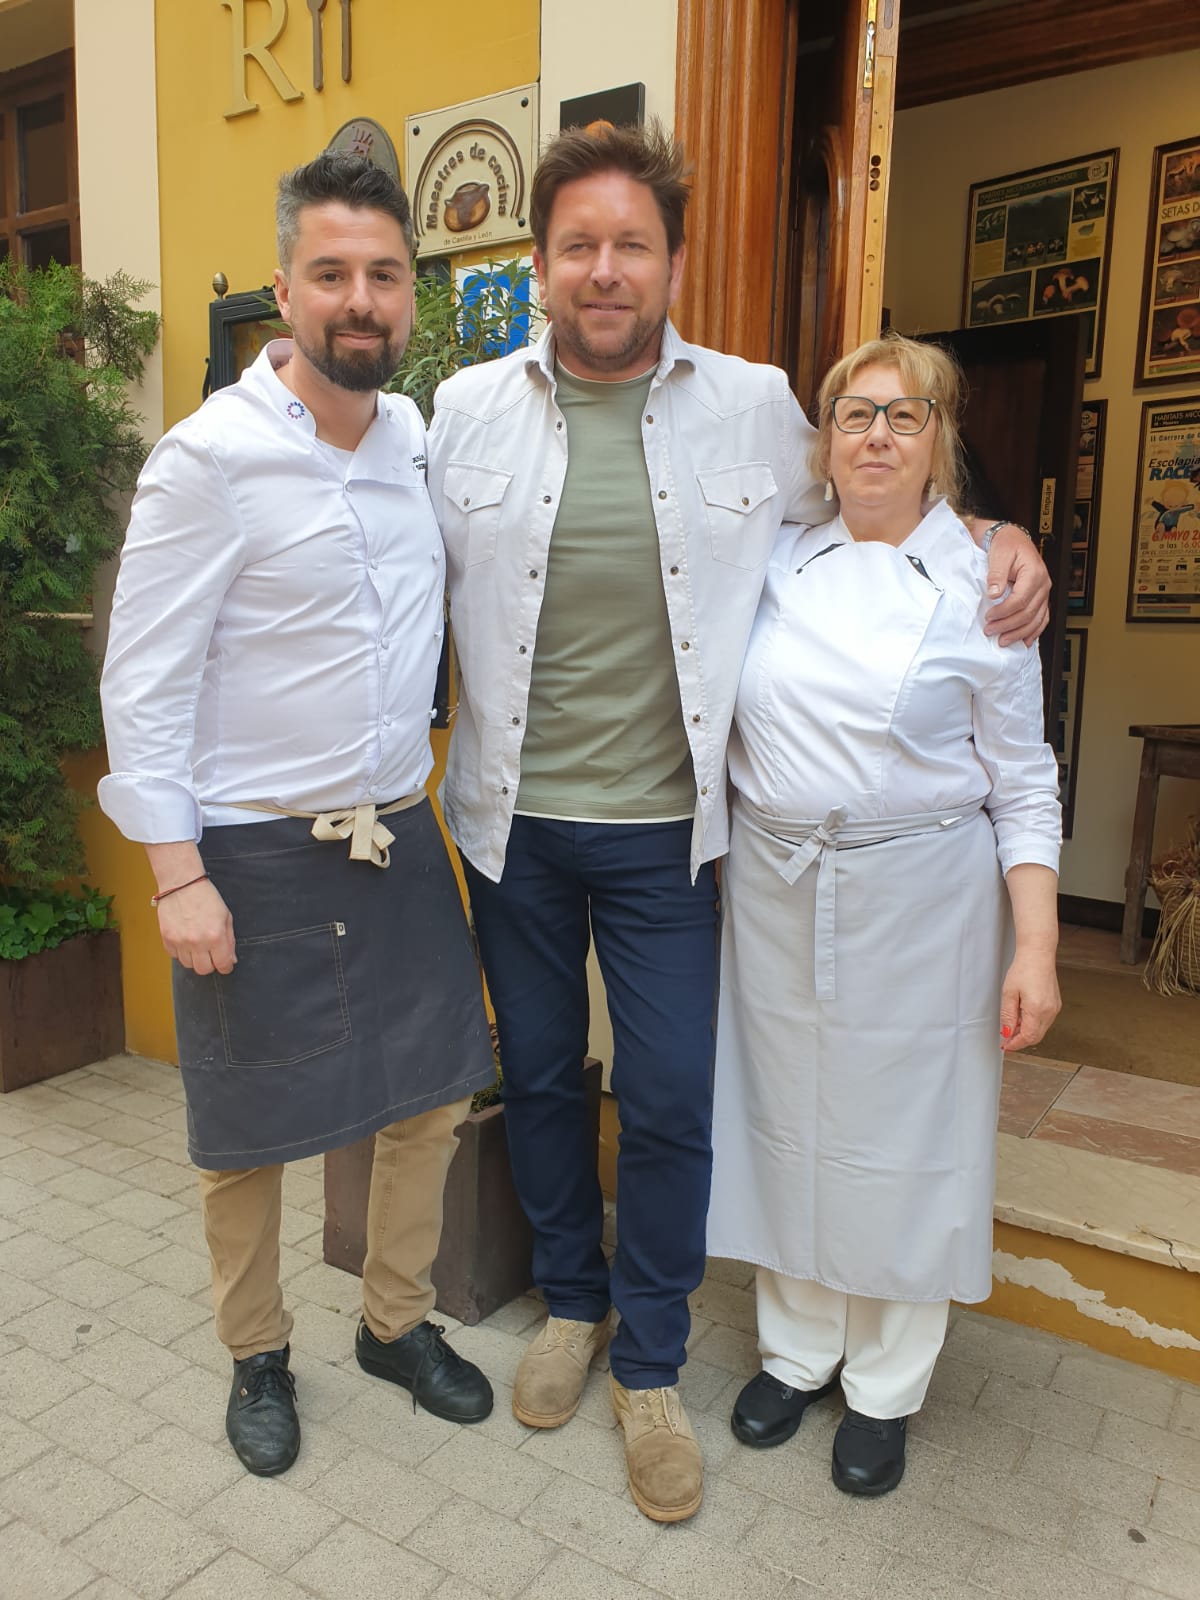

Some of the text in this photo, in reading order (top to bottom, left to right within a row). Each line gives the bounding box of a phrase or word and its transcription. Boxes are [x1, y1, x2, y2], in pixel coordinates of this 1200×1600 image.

[220, 0, 305, 121] R
[426, 142, 510, 229] Maestres de cocina
[1161, 203, 1190, 220] SETAS
[452, 234, 472, 244] Castilla
[1149, 465, 1192, 481] RACE
[1042, 483, 1052, 516] Empujar
[1152, 530, 1160, 542] 6
[1161, 530, 1190, 542] MAYO
[1167, 541, 1177, 549] las
